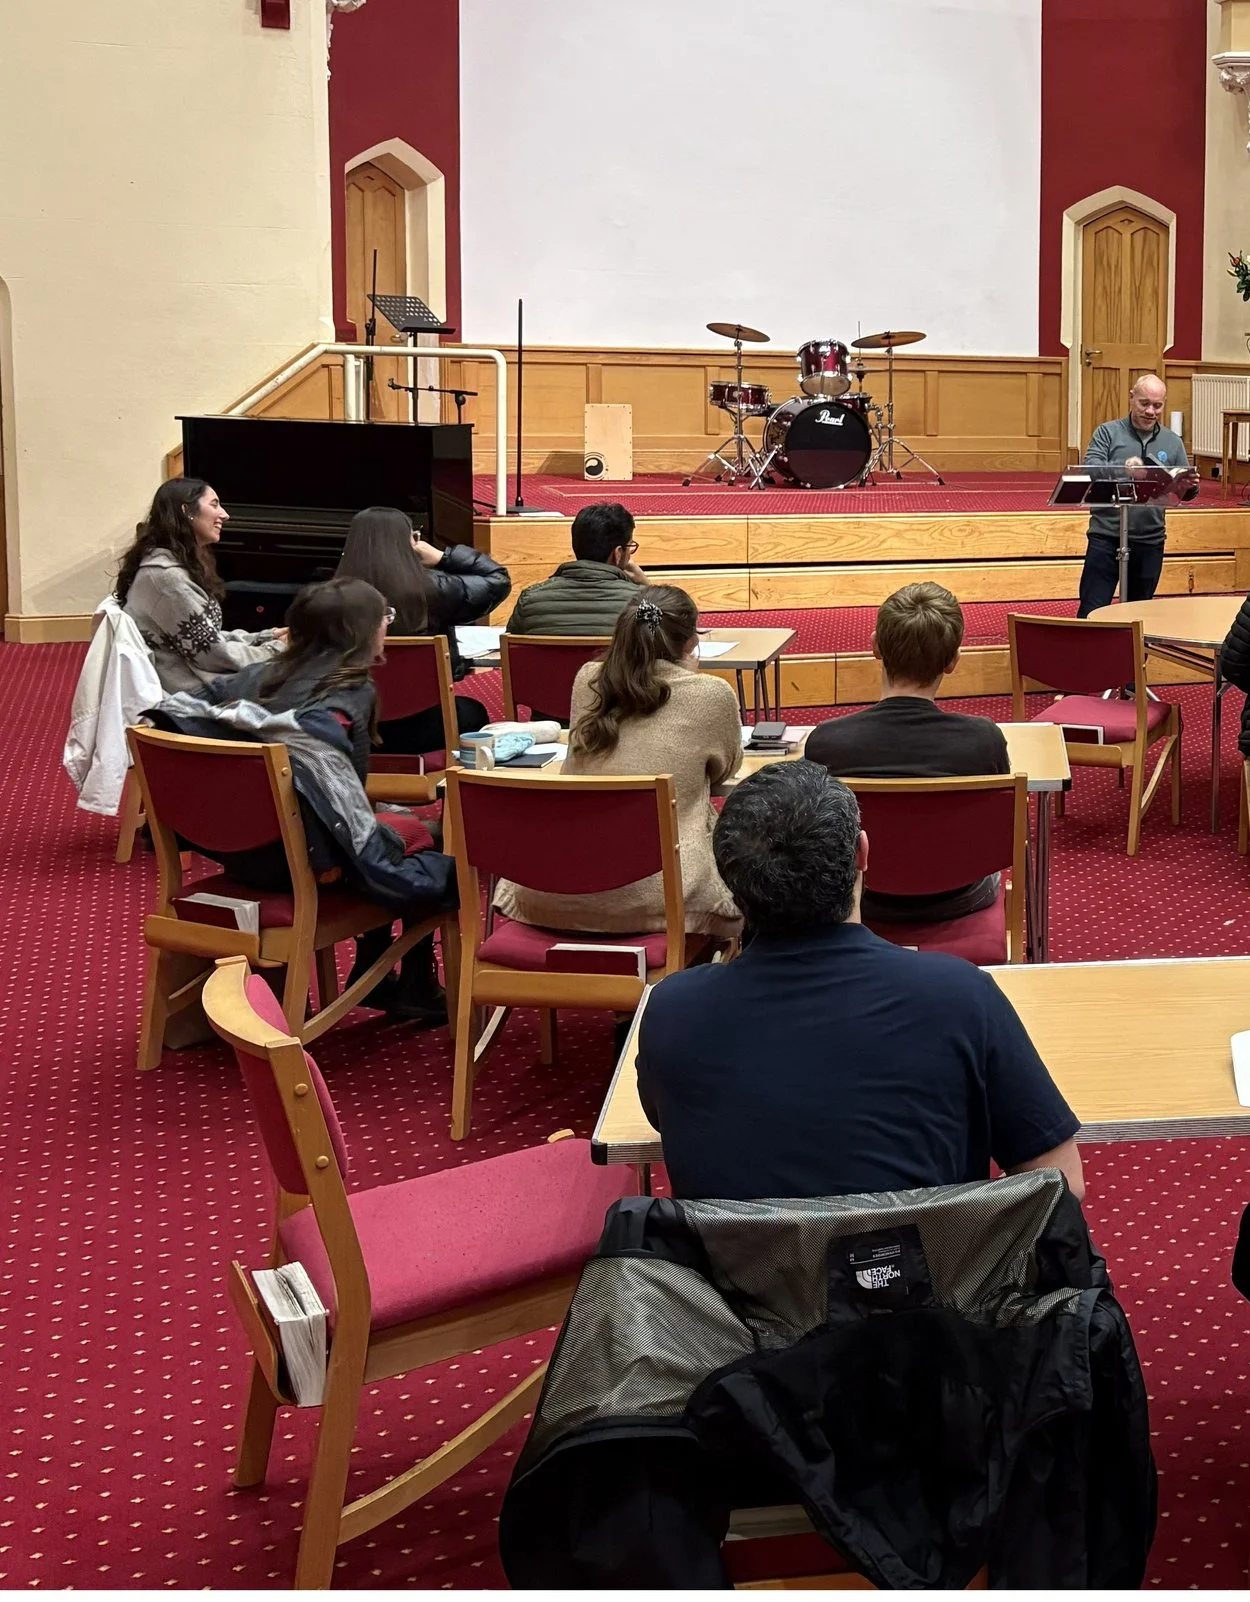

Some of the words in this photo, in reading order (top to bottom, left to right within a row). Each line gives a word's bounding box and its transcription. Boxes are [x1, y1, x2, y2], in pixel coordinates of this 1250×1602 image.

[815, 409, 845, 426] Pearl
[871, 1265, 892, 1275] FACE
[872, 1269, 900, 1282] NORTH
[873, 1279, 889, 1288] THE
